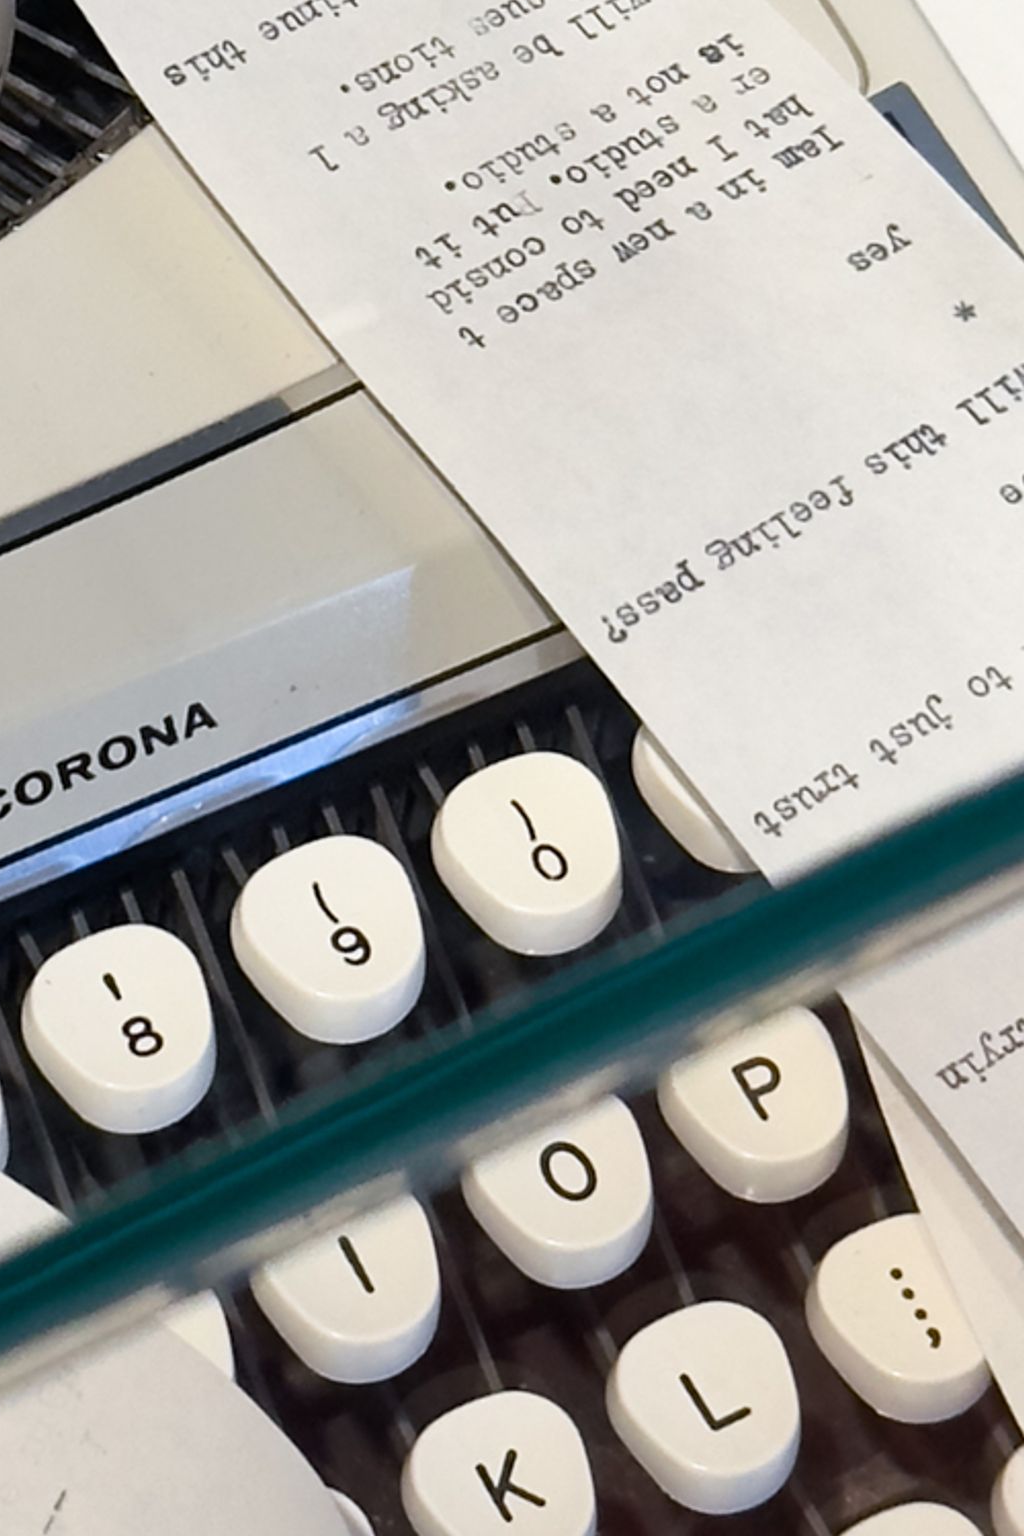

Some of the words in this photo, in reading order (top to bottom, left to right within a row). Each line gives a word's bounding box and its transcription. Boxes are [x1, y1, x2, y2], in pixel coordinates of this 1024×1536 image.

[162, 38, 248, 88] this
[511, 32, 566, 65] be
[696, 32, 746, 65] is
[376, 60, 501, 132] asking
[625, 61, 692, 107] not
[690, 93, 719, 115] a
[729, 66, 772, 96] er
[342, 124, 371, 147] a
[588, 102, 618, 125] a
[742, 92, 816, 140] hat
[443, 121, 578, 193] studio.
[548, 113, 681, 186] studio.
[704, 133, 740, 163] I
[611, 154, 700, 213] need
[714, 167, 768, 201] in
[560, 208, 606, 236] to
[683, 200, 714, 222] a
[414, 231, 463, 271] it
[610, 216, 678, 265] new
[845, 222, 914, 273] yes
[424, 235, 547, 316] consid
[495, 257, 598, 325] space
[457, 325, 487, 350] t
[863, 423, 949, 476] this
[703, 474, 855, 572] feeling
[599, 557, 707, 645] pass?
[966, 665, 1014, 699] to
[868, 693, 954, 766] just
[752, 762, 860, 839] trust
[330, 926, 372, 967] 9
[121, 1016, 164, 1058] 8
[933, 1016, 1024, 1091] ryin
[732, 1056, 782, 1121] P
[539, 1141, 597, 1202] O
[680, 1374, 750, 1430] L
[475, 1450, 546, 1522] K
